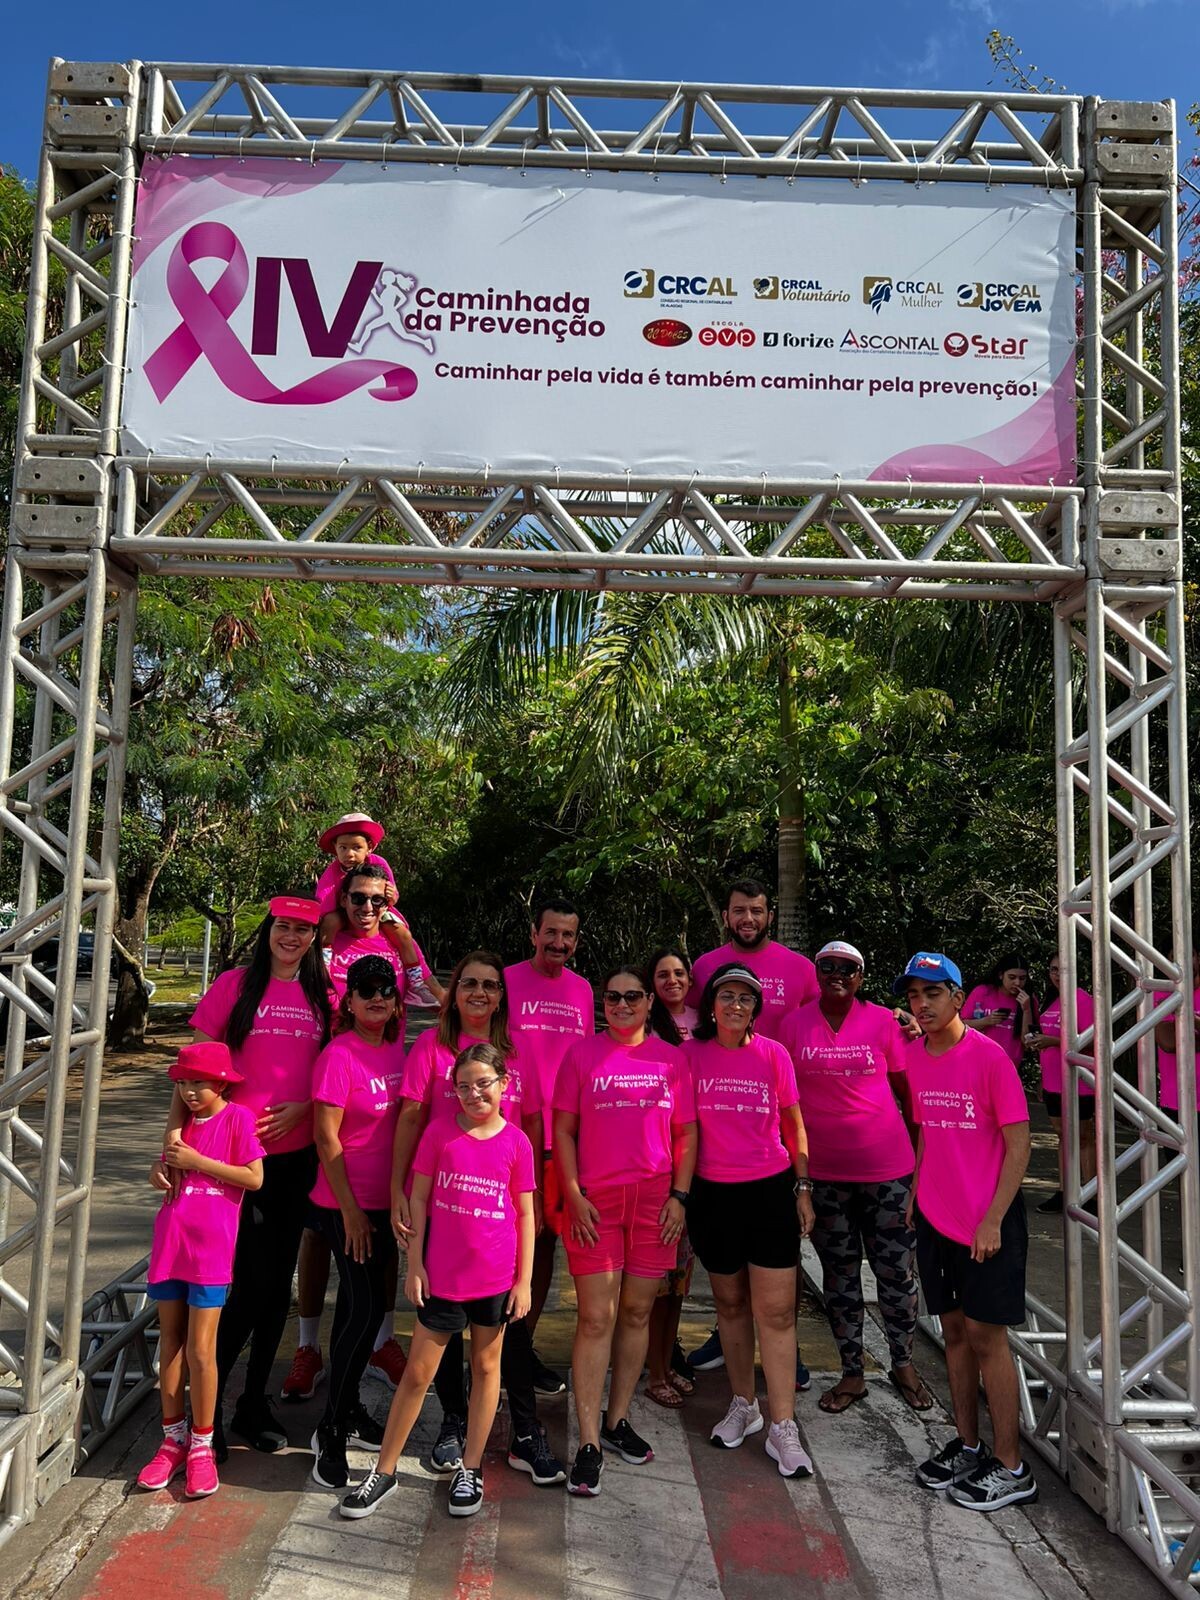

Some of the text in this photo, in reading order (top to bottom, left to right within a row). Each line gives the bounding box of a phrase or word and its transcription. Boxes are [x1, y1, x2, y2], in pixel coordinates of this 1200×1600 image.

[658, 275, 738, 296] CRCAL
[781, 279, 822, 290] CRCAL
[896, 281, 944, 295] CRCAL
[985, 283, 1041, 298] CRCAL
[415, 287, 590, 313] Caminhada
[781, 288, 851, 303] Voluntário
[901, 295, 943, 308] Mulher
[979, 293, 1043, 313] JOVEM
[251, 257, 384, 358] IV
[404, 309, 606, 343] da Prevenção
[783, 332, 834, 348] forize
[840, 328, 940, 351] ASCONTAL
[971, 334, 1029, 355] Star
[435, 362, 1038, 401] Caminhar pela vida é também caminhar pela prevenção!
[521, 1000, 540, 1016] IV
[819, 1045, 860, 1053] CAMINHADA
[819, 1051, 863, 1060] PREVENÇÃO
[592, 1075, 613, 1093] IV
[613, 1073, 659, 1081] CAMINHADA
[614, 1080, 660, 1088] PREVENÇÃO
[715, 1077, 759, 1087] CAMINHADA
[370, 1076, 387, 1095] IV
[698, 1078, 715, 1094] IV
[714, 1085, 759, 1095] PREVENÇÃO
[961, 1093, 974, 1101] DA
[437, 1170, 454, 1189] IV
[453, 1172, 499, 1188] CAMINHADA
